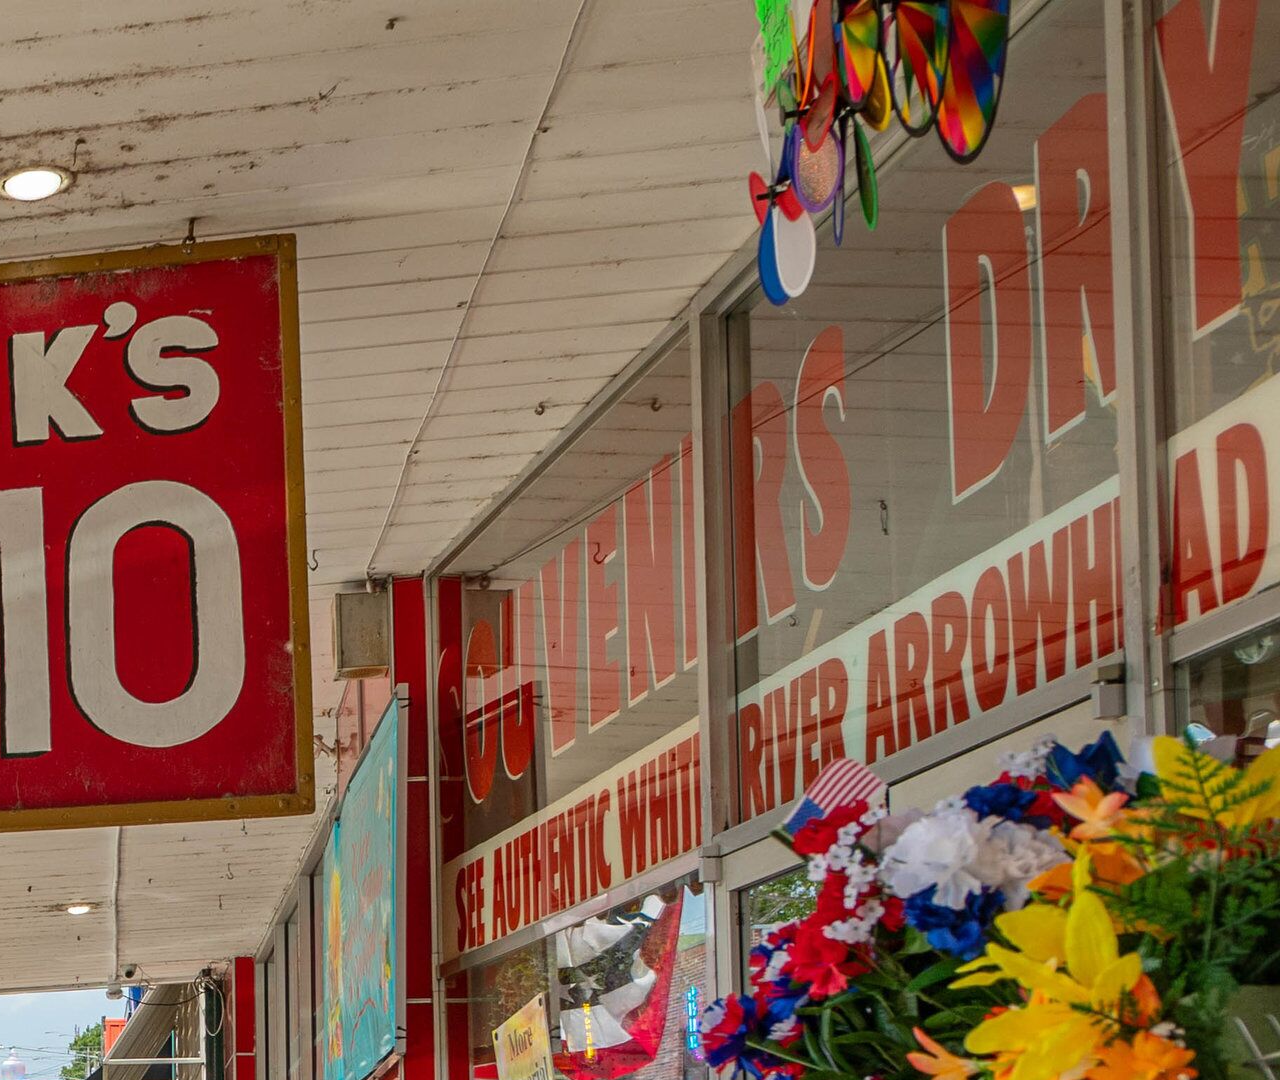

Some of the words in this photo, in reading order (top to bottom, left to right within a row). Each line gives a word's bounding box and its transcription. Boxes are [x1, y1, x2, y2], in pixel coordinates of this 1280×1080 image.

[455, 857, 486, 953] SEE
[491, 788, 611, 941] AUTHENTIC
[739, 657, 848, 822] RIVER
[507, 1025, 533, 1061] More
